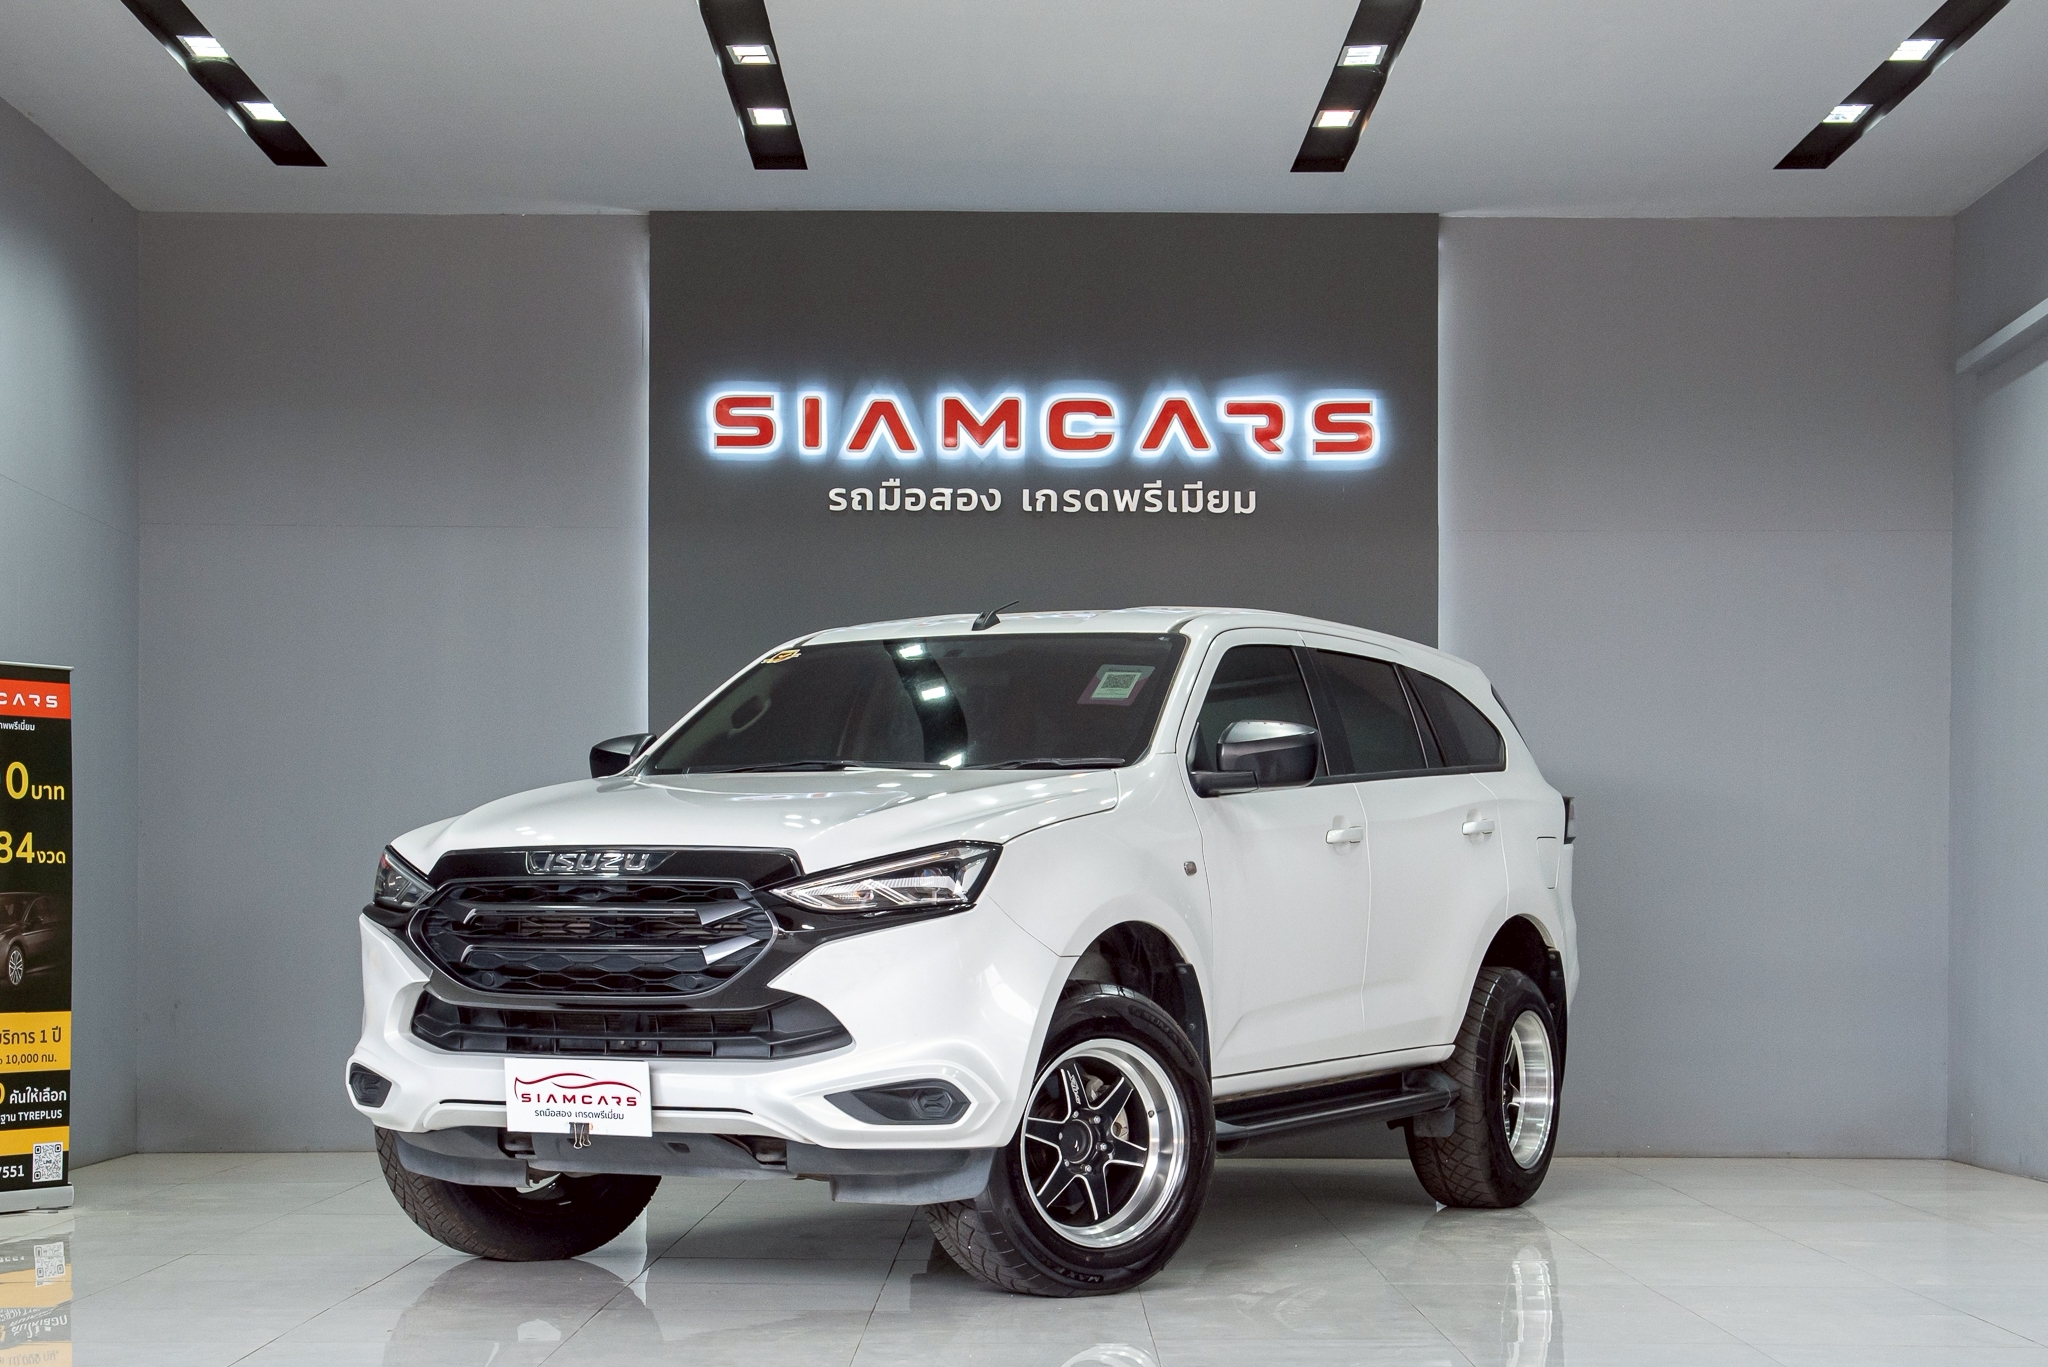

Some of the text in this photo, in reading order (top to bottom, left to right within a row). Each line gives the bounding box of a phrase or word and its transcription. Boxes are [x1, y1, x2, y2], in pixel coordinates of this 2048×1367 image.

[712, 394, 1376, 456] SIAMCARS
[828, 478, 1257, 514] รถมือสอง เกรดพรีเมียม
[543, 852, 650, 872] ISUZU
[0, 1025, 61, 1045] ริการ 1 ปี
[6, 1053, 39, 1066] 10,000
[41, 1053, 57, 1063] กม.
[9, 1086, 67, 1104] คันให้เลือก
[521, 1093, 637, 1107] SIAMCARS
[18, 1109, 63, 1121] TYREPLUS
[534, 1108, 572, 1118] รถมือสอง
[0, 1164, 25, 1179] 551
